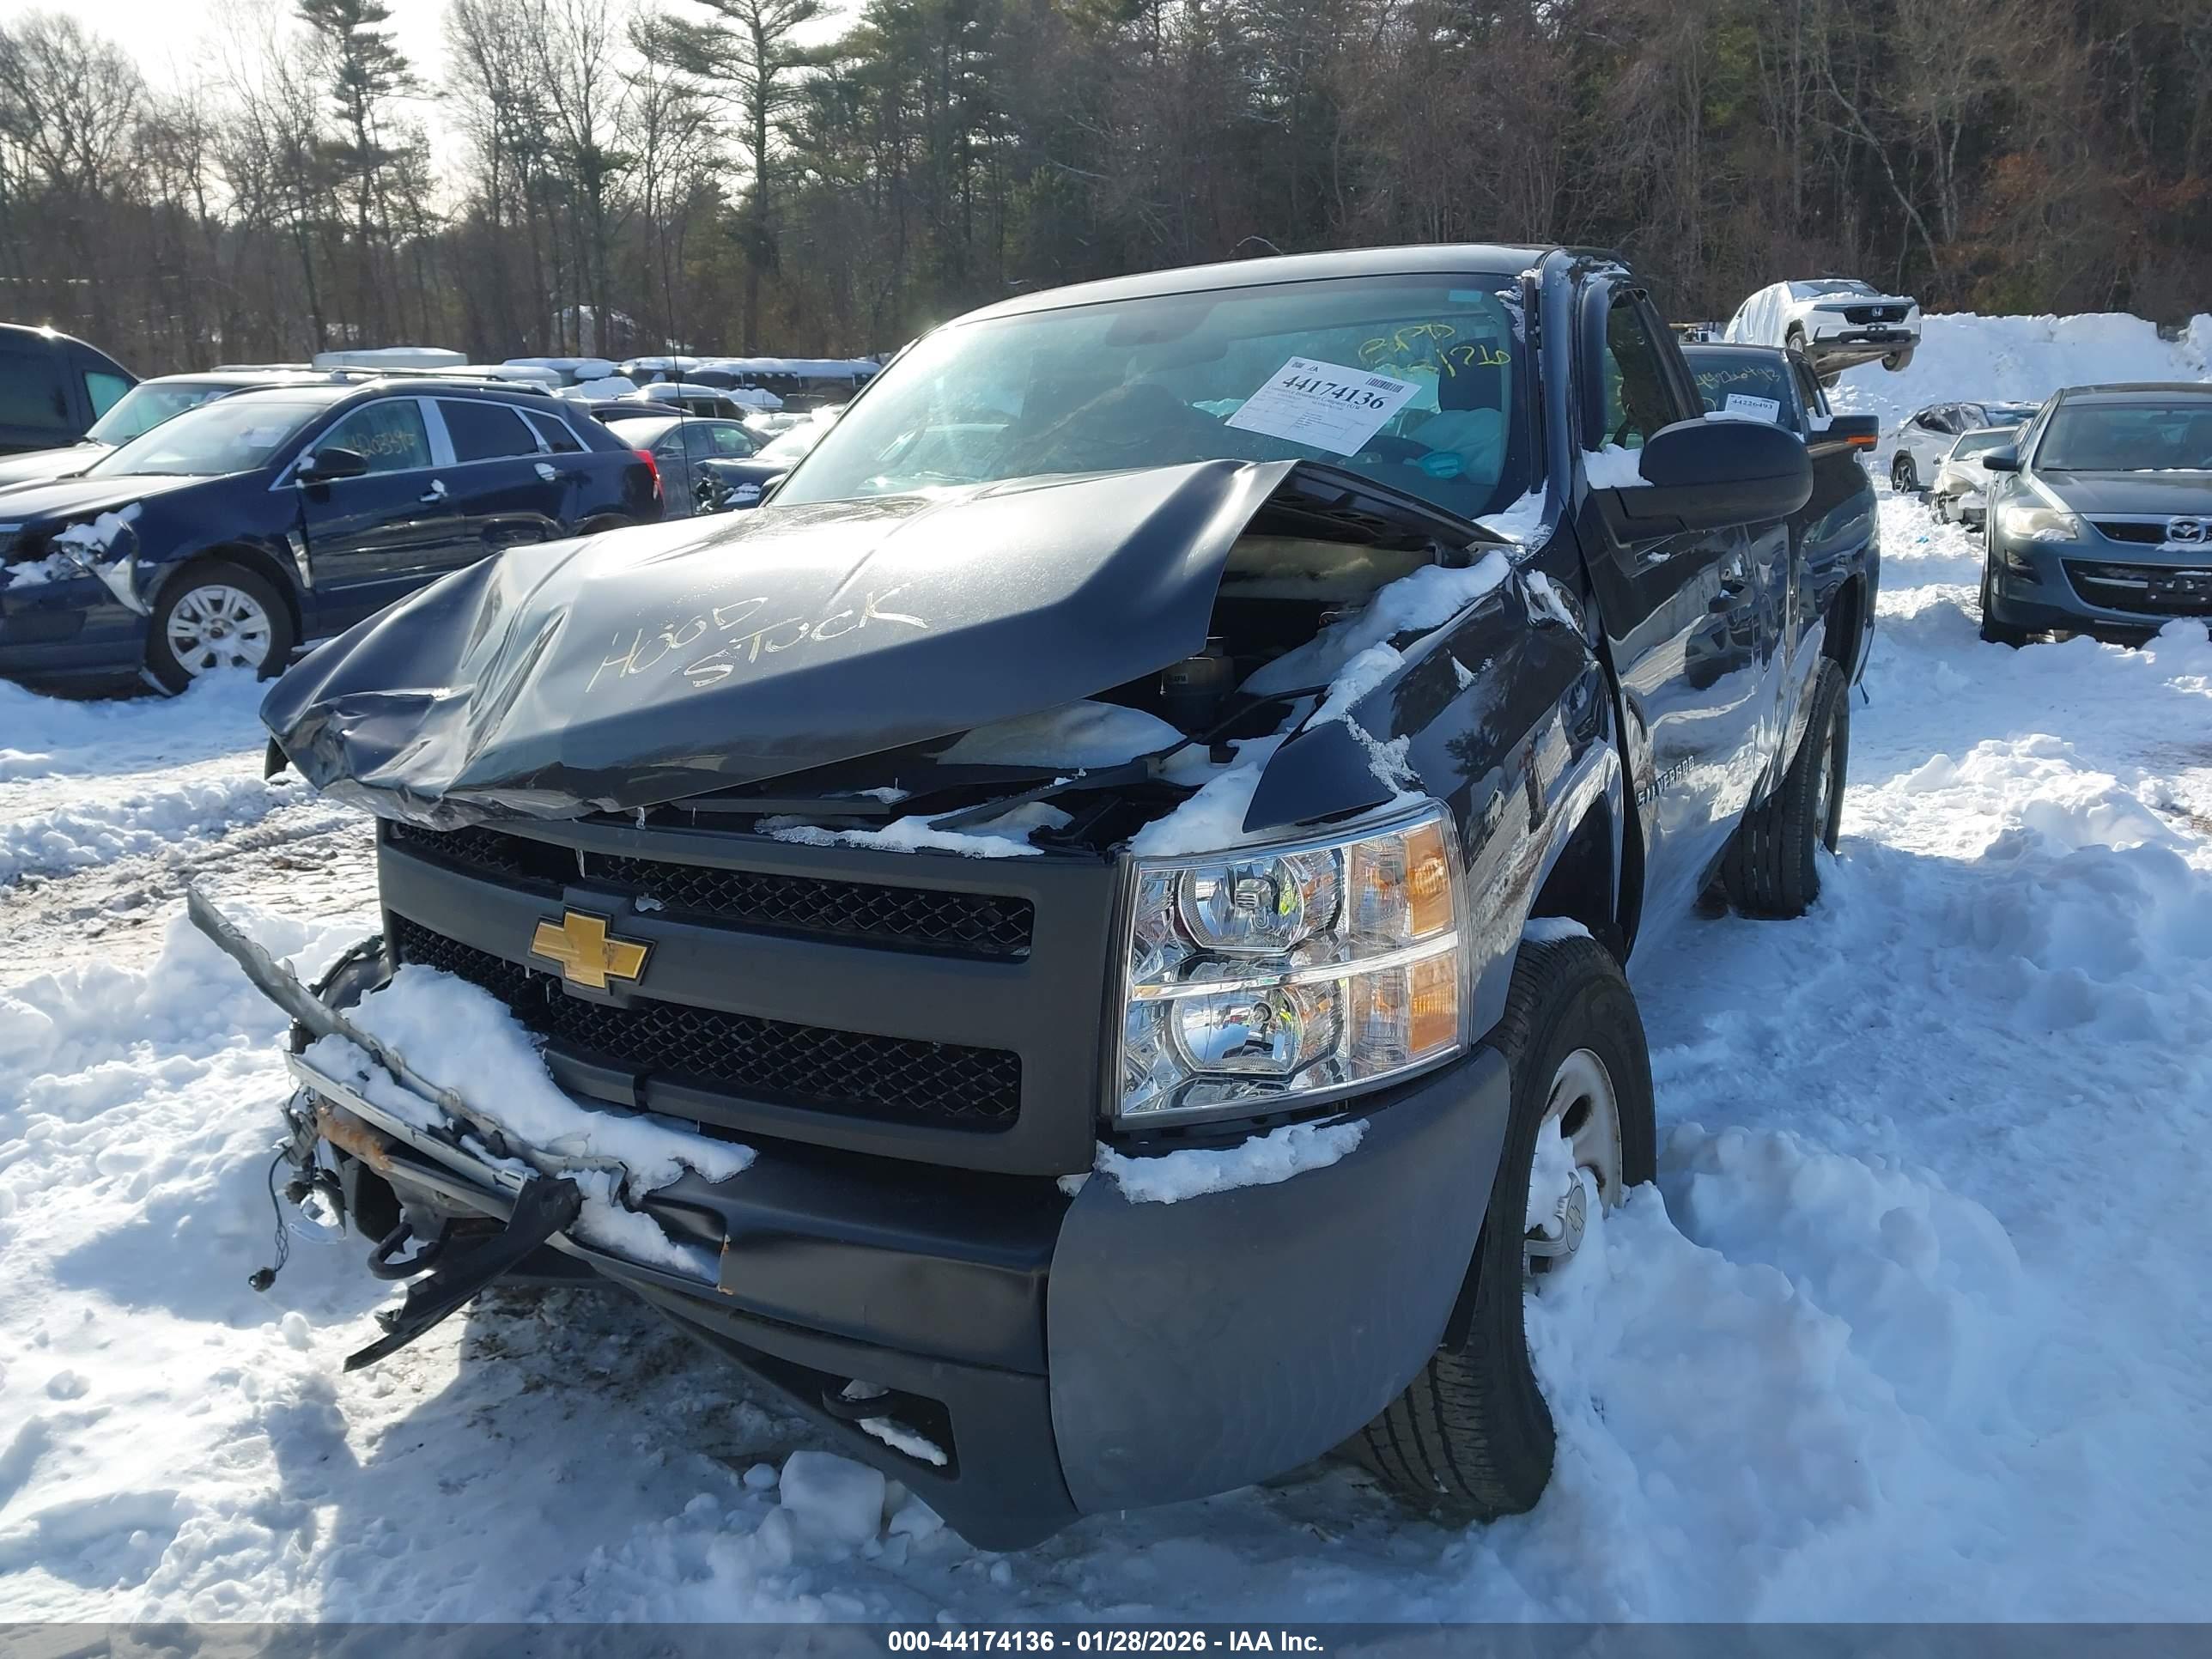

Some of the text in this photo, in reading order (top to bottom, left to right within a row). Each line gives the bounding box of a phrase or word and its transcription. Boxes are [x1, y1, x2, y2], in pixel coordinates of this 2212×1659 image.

[1282, 374, 1389, 410] 44174136
[1731, 398, 1773, 410] 44226493
[585, 596, 769, 694] HOOD
